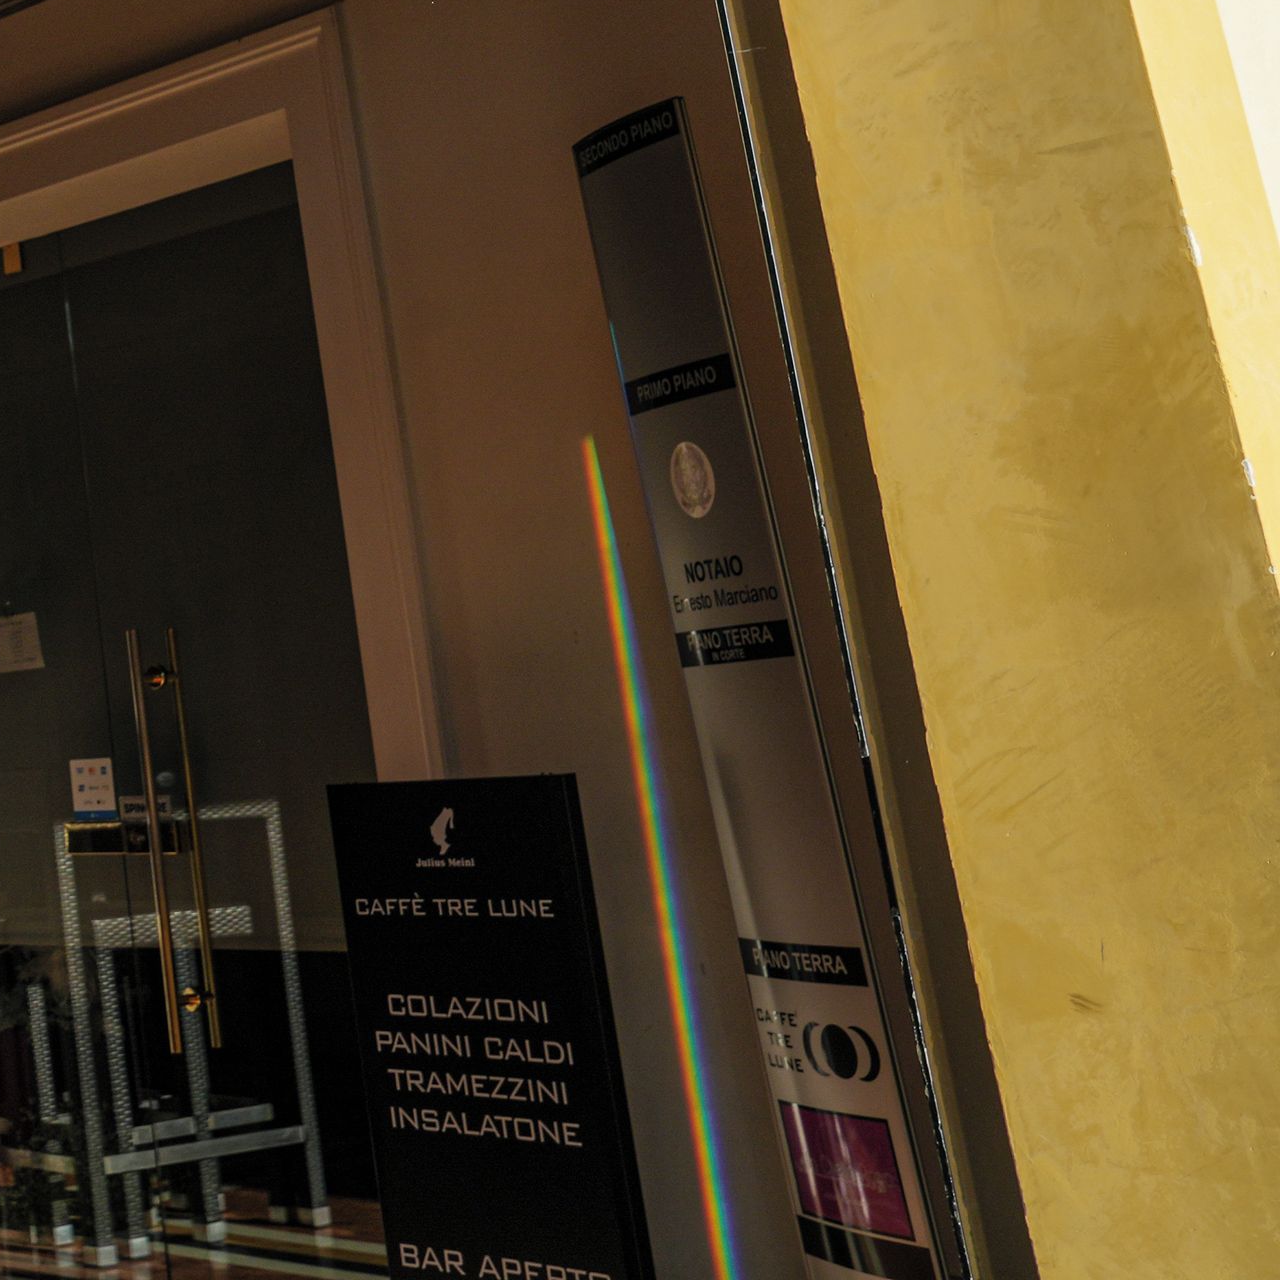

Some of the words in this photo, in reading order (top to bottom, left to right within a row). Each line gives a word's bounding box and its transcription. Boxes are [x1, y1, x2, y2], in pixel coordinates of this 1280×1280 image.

[578, 129, 630, 168] SECONDO
[630, 111, 673, 143] PIANO
[636, 378, 671, 403] PRIMO
[673, 366, 717, 395] PIANO
[684, 554, 743, 584] NOTAIO
[673, 594, 712, 613] Eresto
[713, 584, 778, 607] Marciano
[722, 624, 775, 648] TERRA
[416, 857, 446, 868] Julius
[448, 857, 475, 868] Meinl
[355, 893, 426, 918] CAFFÈ
[433, 899, 479, 917] TRE
[488, 899, 555, 918] LUNE
[791, 951, 849, 976] TERRA
[387, 993, 549, 1023] COLAZIONI
[375, 1030, 471, 1058] PANINI
[483, 1037, 575, 1066] CALDI
[387, 1068, 568, 1106] TRAMEZZINI
[390, 1106, 583, 1148] INSALATONE
[399, 1242, 466, 1276] BAR
